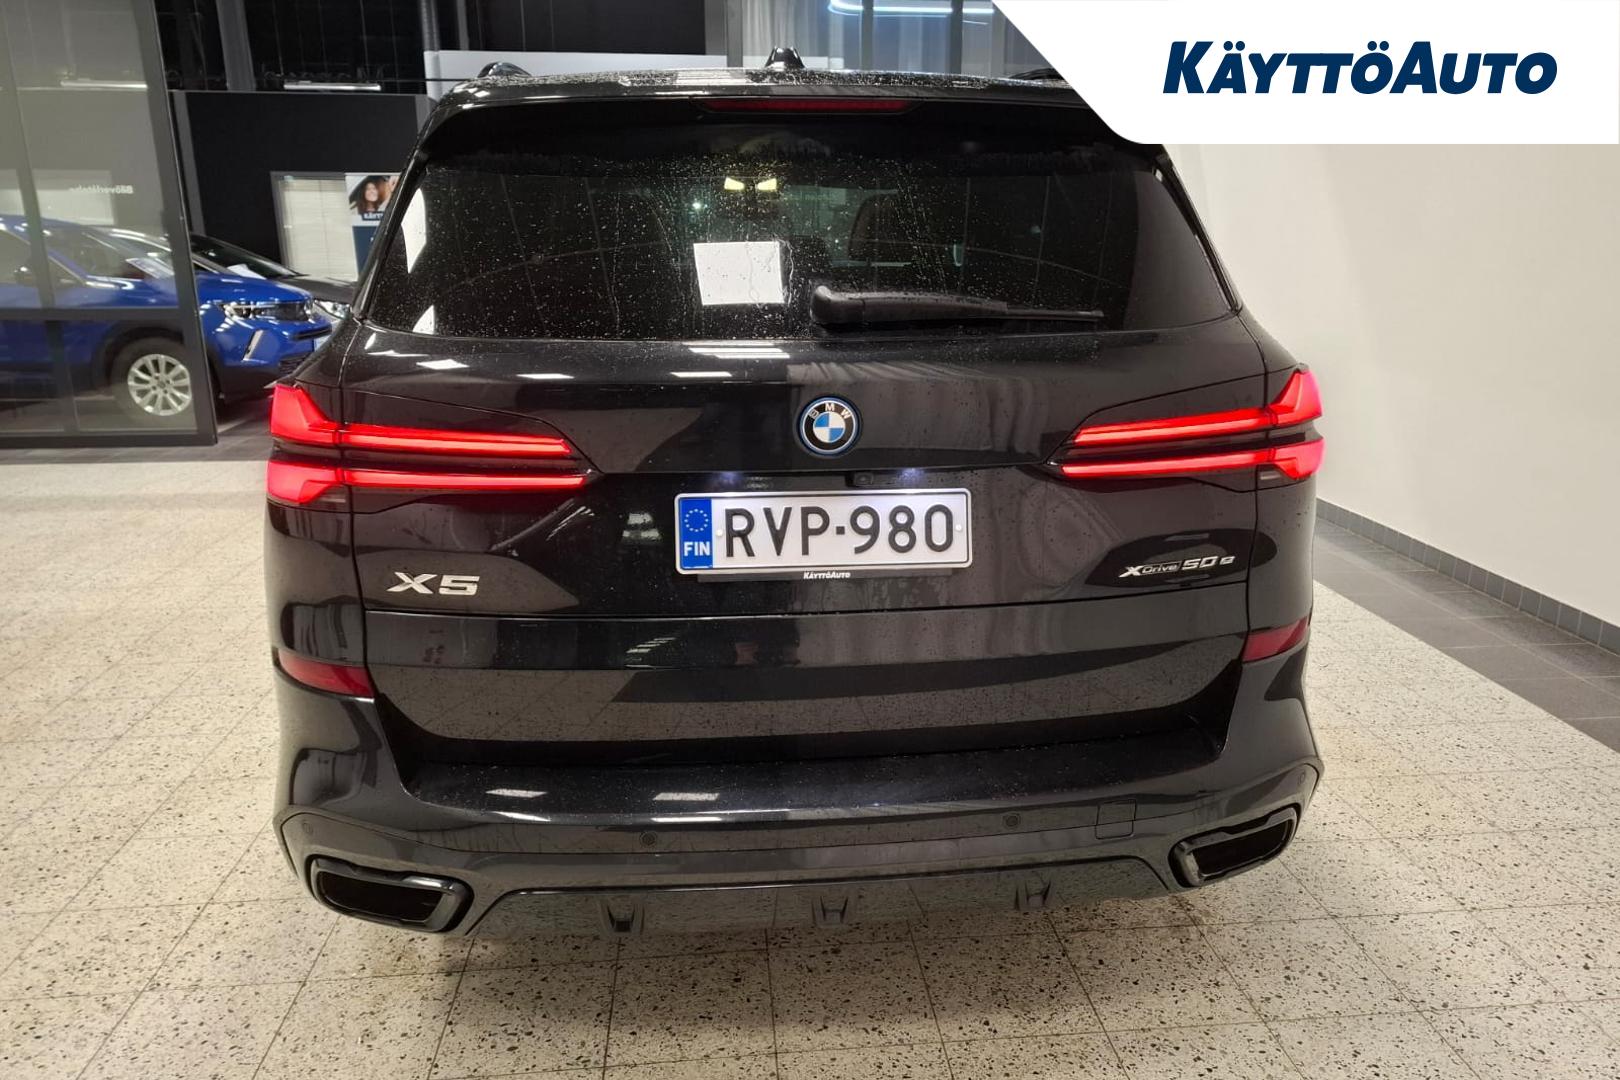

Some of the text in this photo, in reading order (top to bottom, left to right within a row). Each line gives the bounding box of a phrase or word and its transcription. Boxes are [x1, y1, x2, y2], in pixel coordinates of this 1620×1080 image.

[809, 402, 852, 420] BMW
[724, 504, 954, 558] RVP-980
[684, 541, 710, 557] FIN
[386, 571, 480, 596] X5
